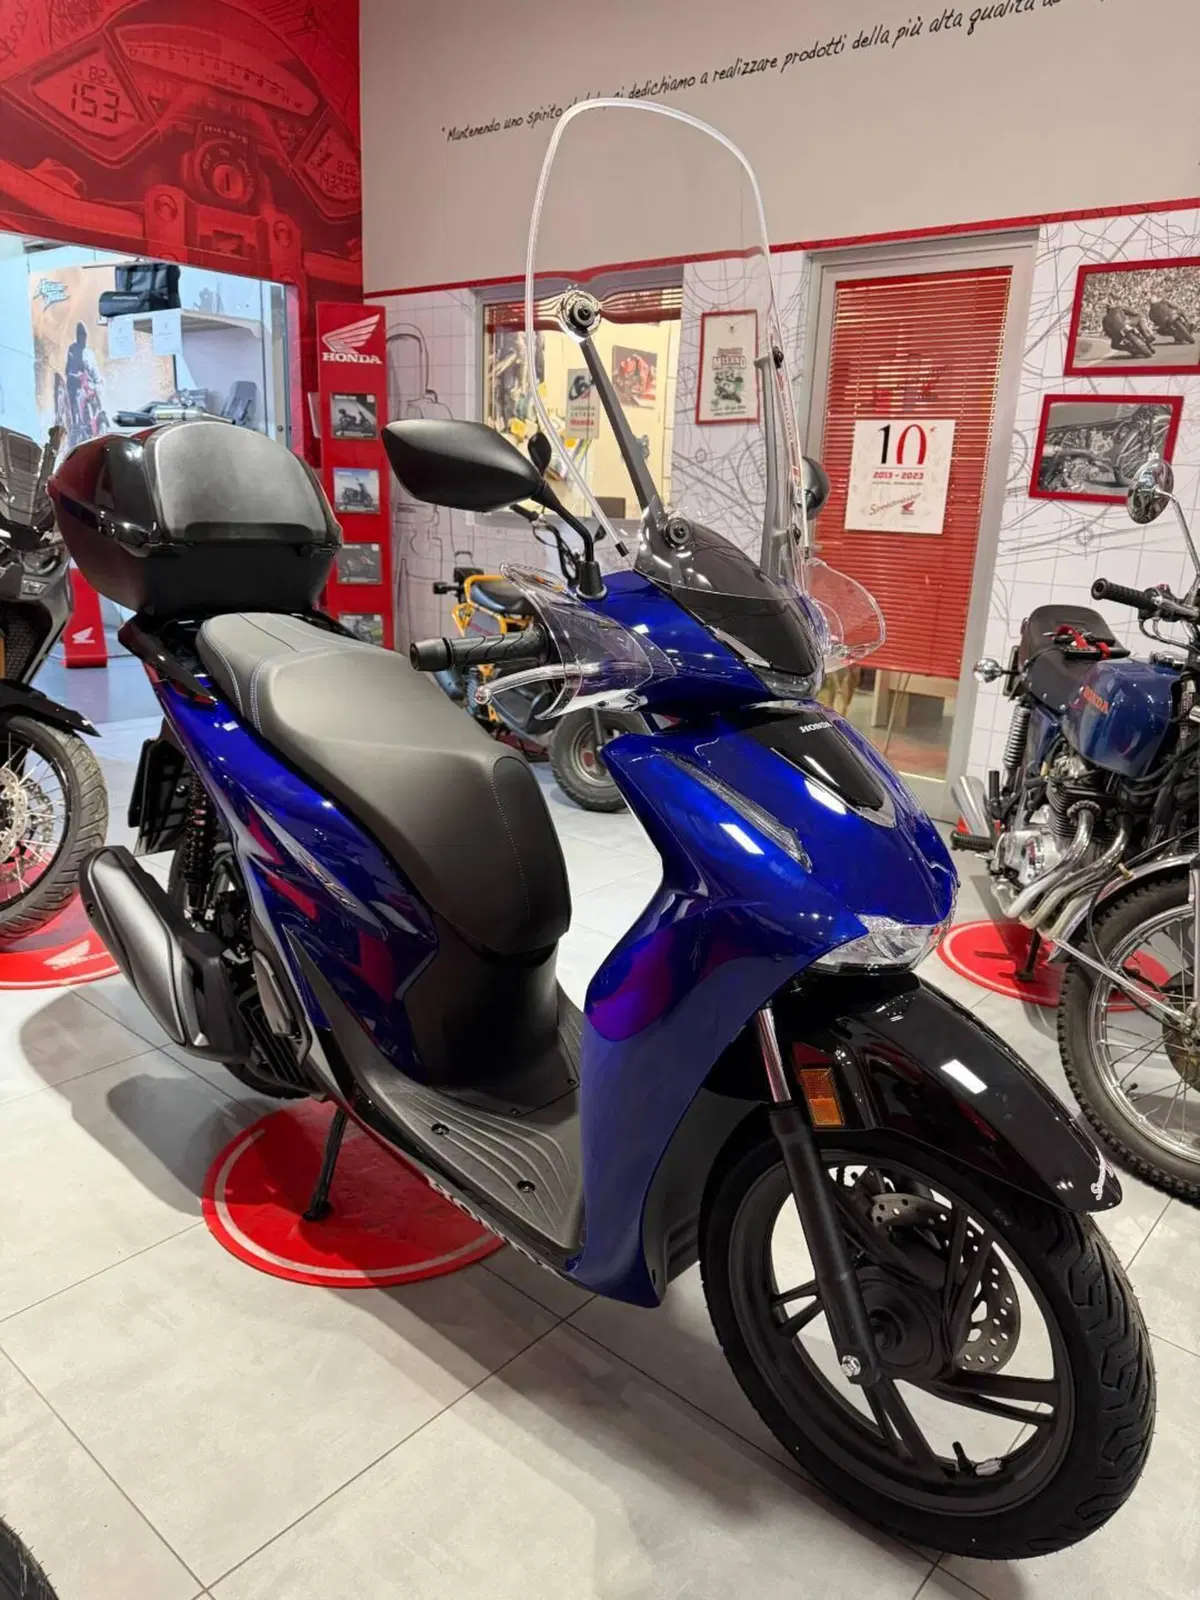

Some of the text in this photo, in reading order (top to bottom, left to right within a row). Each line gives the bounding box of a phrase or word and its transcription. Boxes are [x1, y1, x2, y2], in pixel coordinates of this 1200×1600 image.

[503, 117, 523, 130] uno
[526, 103, 563, 129] spirito
[628, 74, 696, 99] dedichiamo
[700, 72, 708, 84] a
[713, 58, 778, 82] realizzare
[780, 34, 847, 73] prodotti
[852, 24, 890, 49] della
[891, 16, 923, 49] più
[929, 8, 963, 33] alta
[322, 352, 383, 364] HONDA
[901, 471, 924, 480] 2023
[799, 721, 833, 733] HONDA
